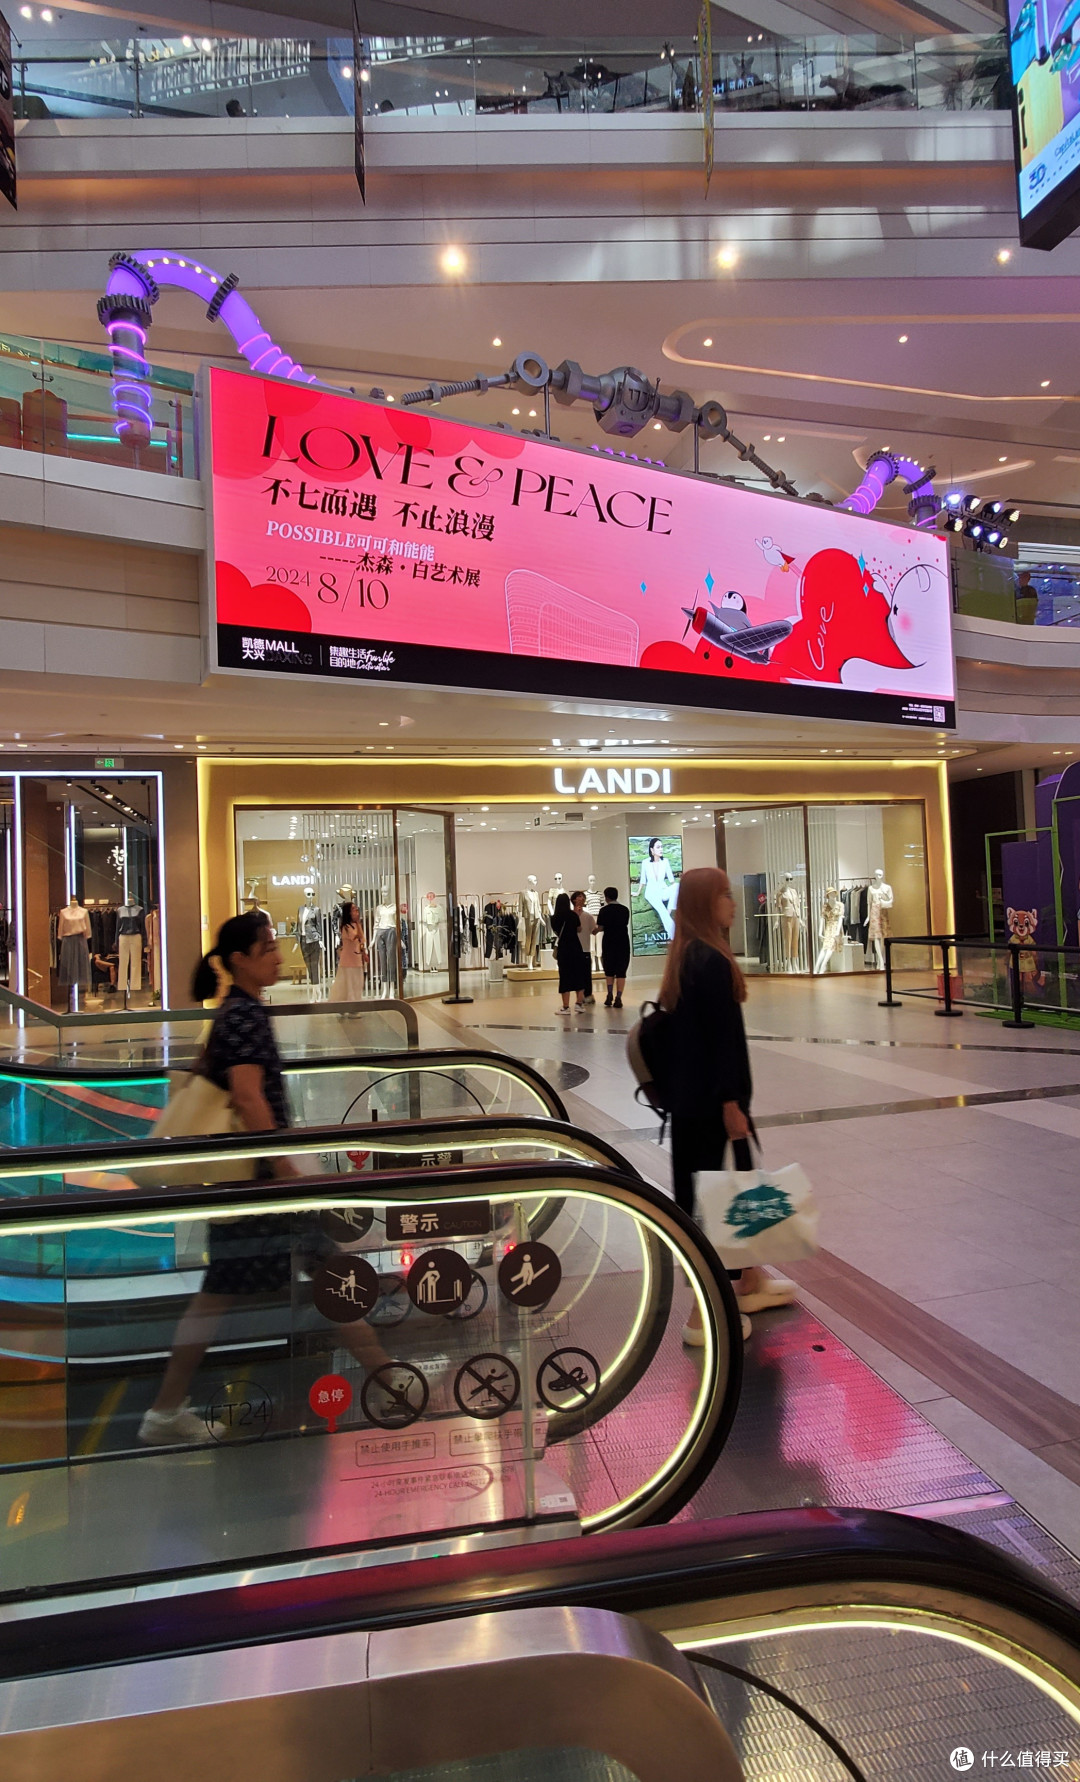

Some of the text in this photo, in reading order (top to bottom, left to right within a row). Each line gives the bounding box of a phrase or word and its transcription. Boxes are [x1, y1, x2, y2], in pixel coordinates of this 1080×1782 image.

[261, 415, 673, 536] LOVE & PEACE
[261, 476, 496, 542] 不七而遇 不止浪漫
[265, 566, 389, 612] 2024 8/10
[554, 767, 671, 794] LANDI
[271, 875, 315, 886] LANDI
[644, 932, 671, 941] LAND
[400, 1212, 439, 1234] 警示
[318, 1388, 344, 1404] 急停
[210, 1400, 270, 1429] FT24
[360, 1437, 432, 1455] 禁止使用手推车
